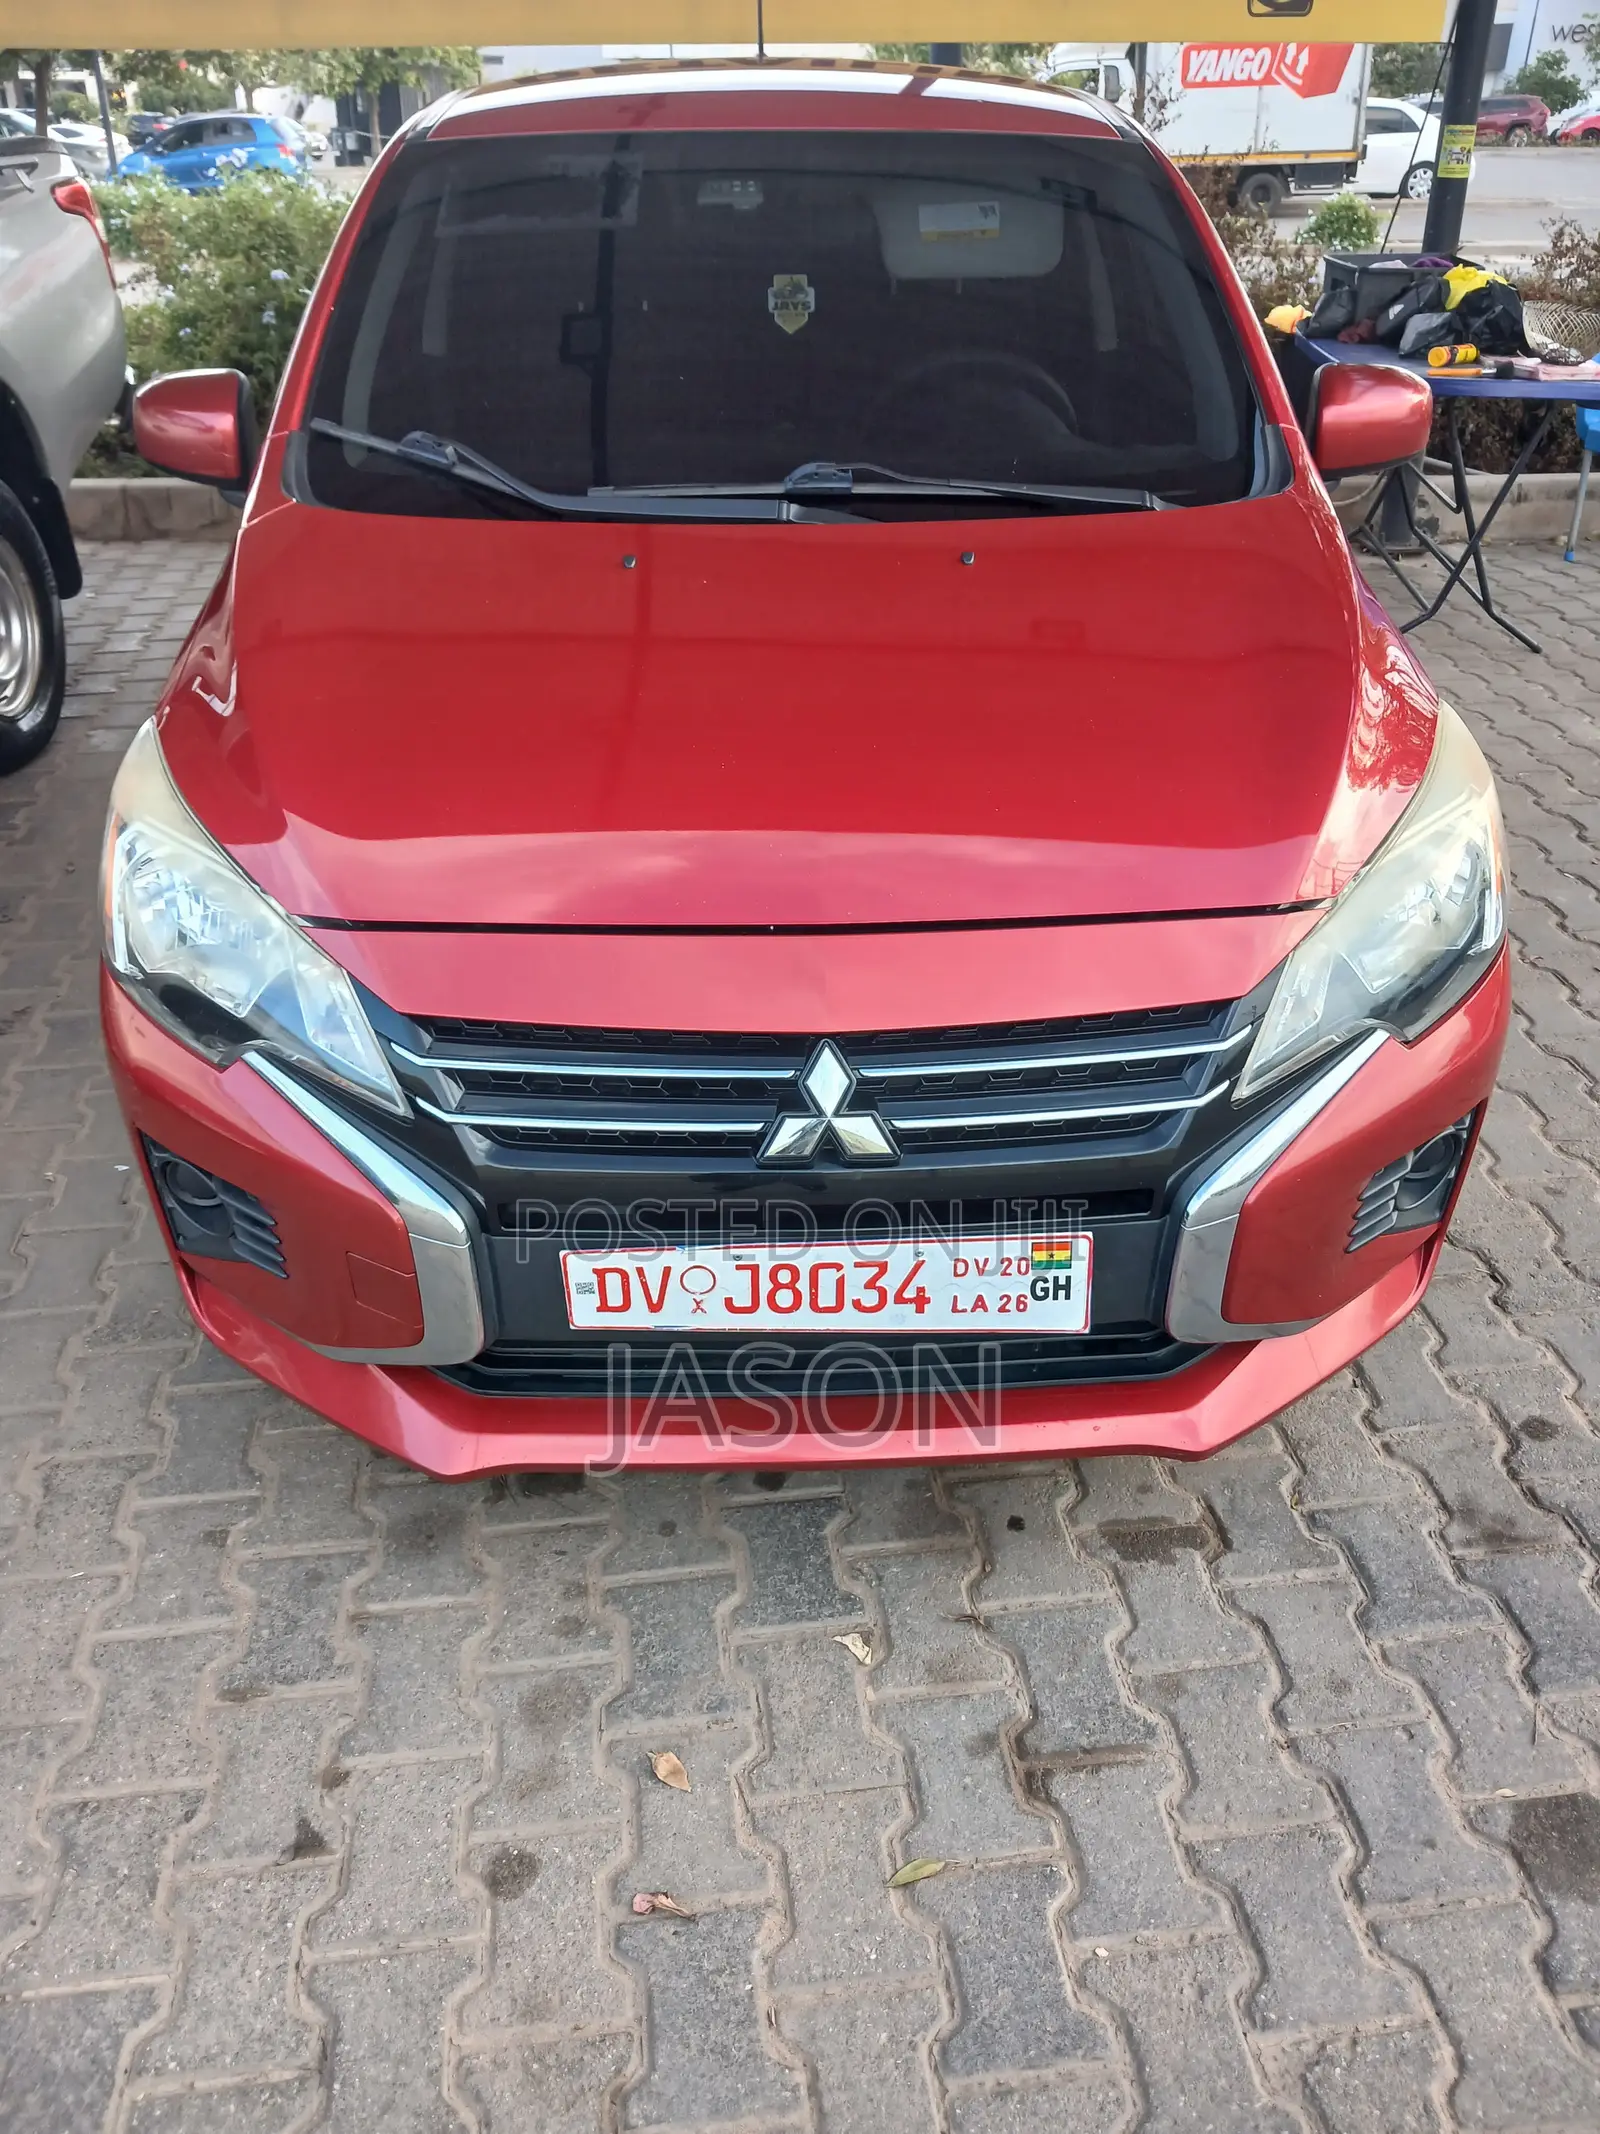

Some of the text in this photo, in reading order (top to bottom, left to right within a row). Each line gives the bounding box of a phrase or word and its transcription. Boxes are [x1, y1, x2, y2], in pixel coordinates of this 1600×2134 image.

[1186, 47, 1272, 83] YANGO
[953, 1256, 1030, 1277] DV 20
[592, 1266, 672, 1313] DV
[724, 1260, 931, 1314] J8034
[1030, 1275, 1072, 1301] GH
[951, 1293, 1029, 1313] LA 26
